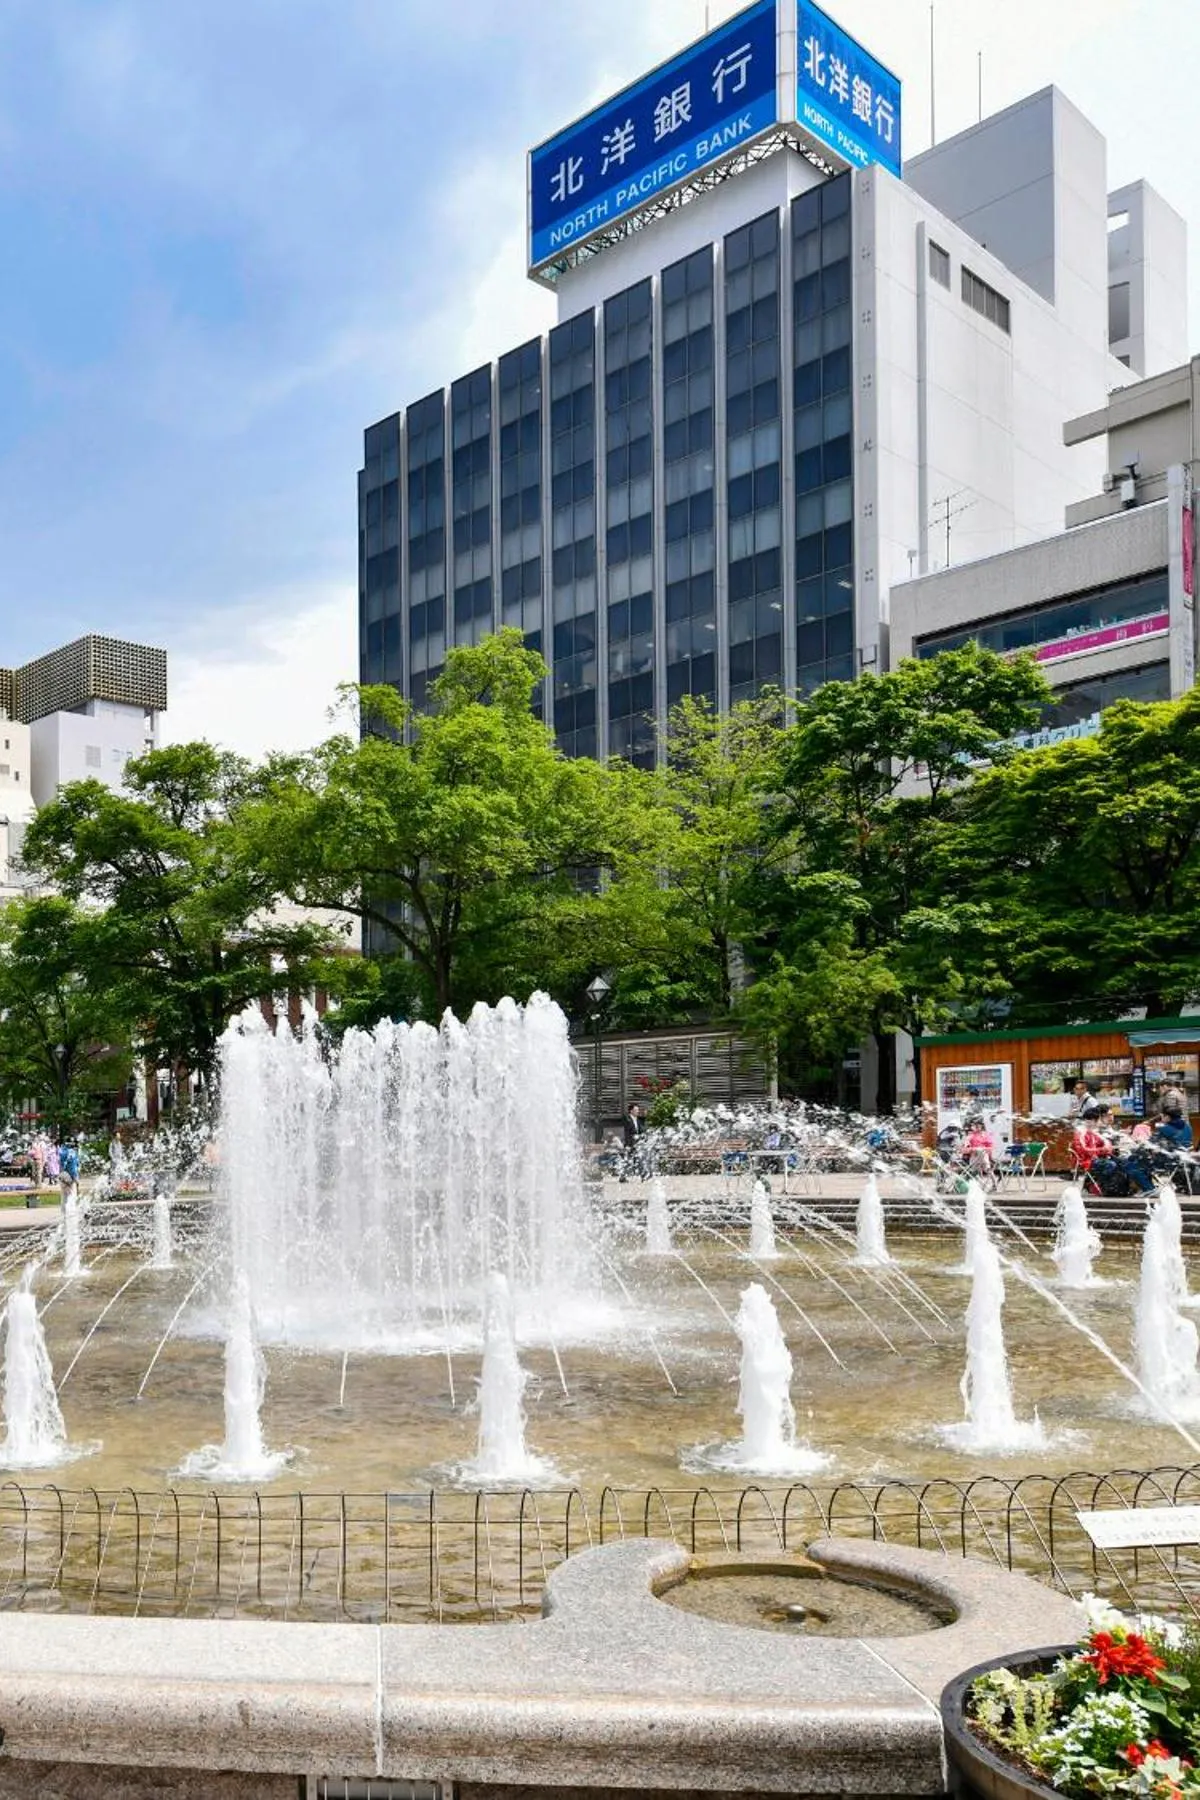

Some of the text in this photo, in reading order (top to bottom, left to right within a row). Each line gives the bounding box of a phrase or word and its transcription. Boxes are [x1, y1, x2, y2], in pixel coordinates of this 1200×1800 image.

[551, 43, 752, 202] 北洋銀行
[804, 35, 894, 143] 北洋銀行
[804, 102, 869, 165] NORTH PACIFIC
[550, 112, 752, 247] NORTH PACIFIC BANK
